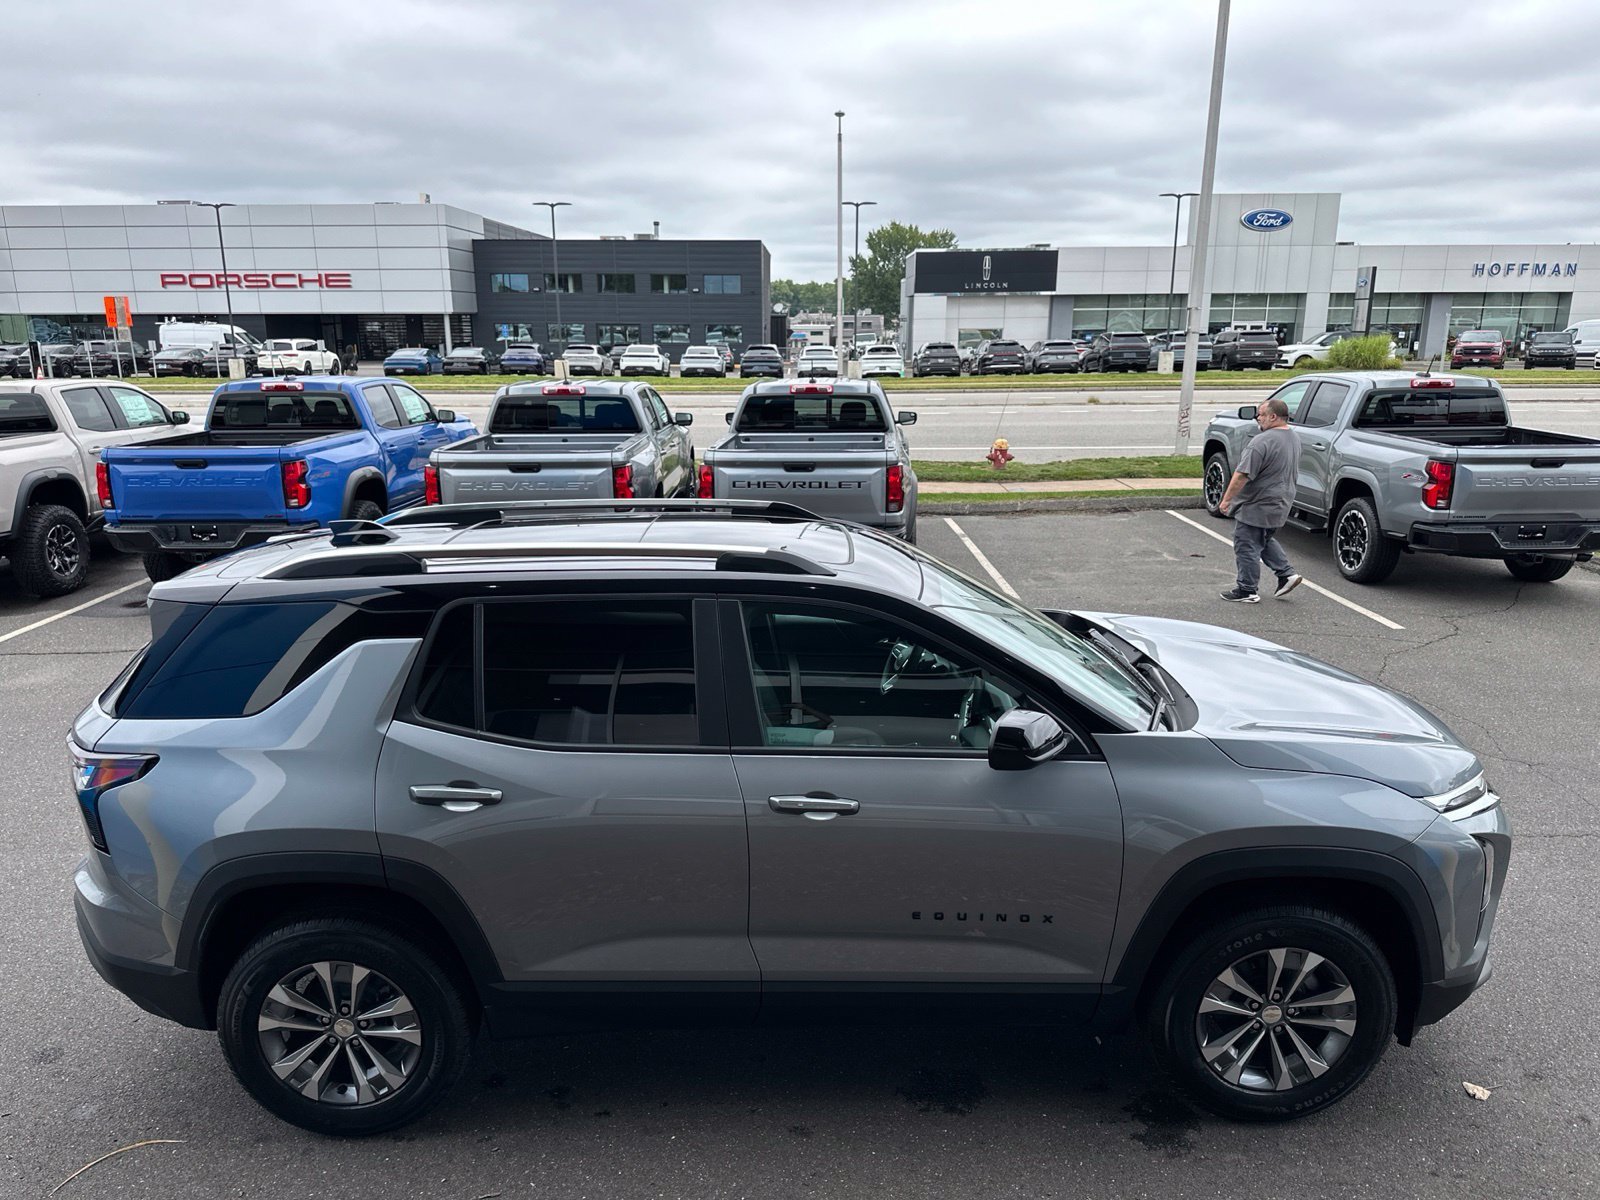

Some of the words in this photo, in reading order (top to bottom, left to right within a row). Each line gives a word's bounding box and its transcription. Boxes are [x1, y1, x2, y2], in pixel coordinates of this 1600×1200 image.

[1253, 212, 1284, 226] Ford
[1473, 263, 1577, 276] HOFFMAN
[160, 273, 352, 289] PORSCHE
[127, 477, 263, 487] CHEVROLET
[458, 481, 594, 491] CHEVROLET
[732, 480, 867, 489] CHEVROLET
[911, 911, 1054, 924] EQUINOX
